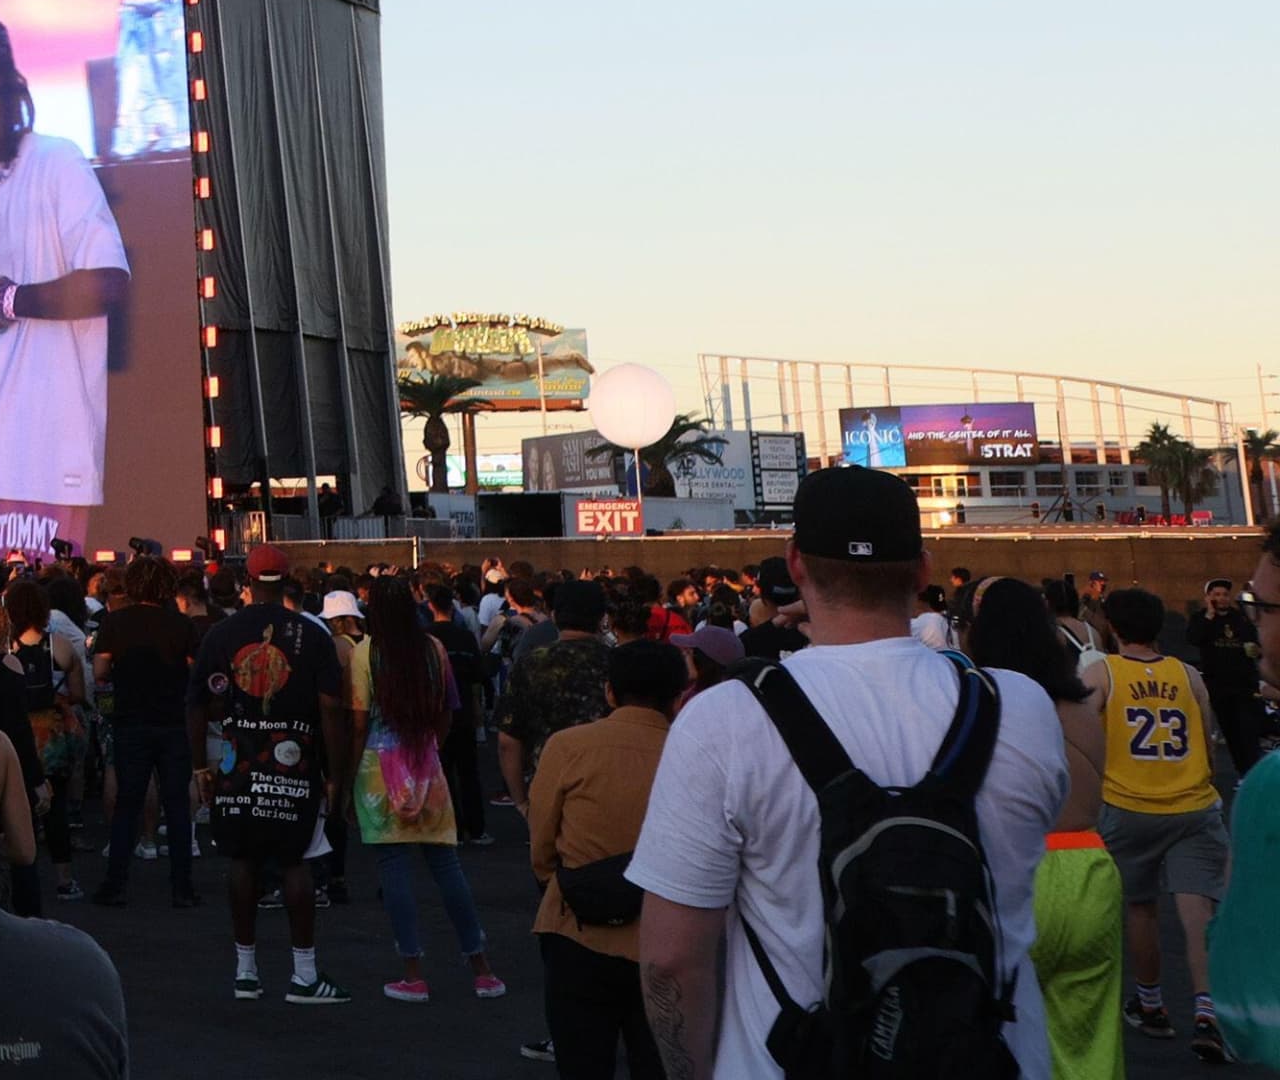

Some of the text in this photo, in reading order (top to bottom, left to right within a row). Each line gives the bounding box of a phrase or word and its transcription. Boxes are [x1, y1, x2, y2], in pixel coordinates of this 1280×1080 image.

[845, 426, 901, 446] ICONIC
[907, 431, 925, 440] AND
[927, 431, 946, 439] THE
[948, 430, 985, 439] CENTER
[987, 429, 999, 438] OF
[1002, 429, 1011, 438] IT
[984, 443, 1034, 458] STRAT
[578, 501, 638, 512] EMERGENCY
[578, 511, 639, 532] EXIT
[1129, 680, 1179, 701] JAMES
[237, 719, 257, 729] the
[259, 721, 288, 730] Moon
[1124, 706, 1189, 761] 23
[250, 771, 310, 787] The Chosen
[236, 795, 251, 805] on
[251, 806, 299, 822] Curious
